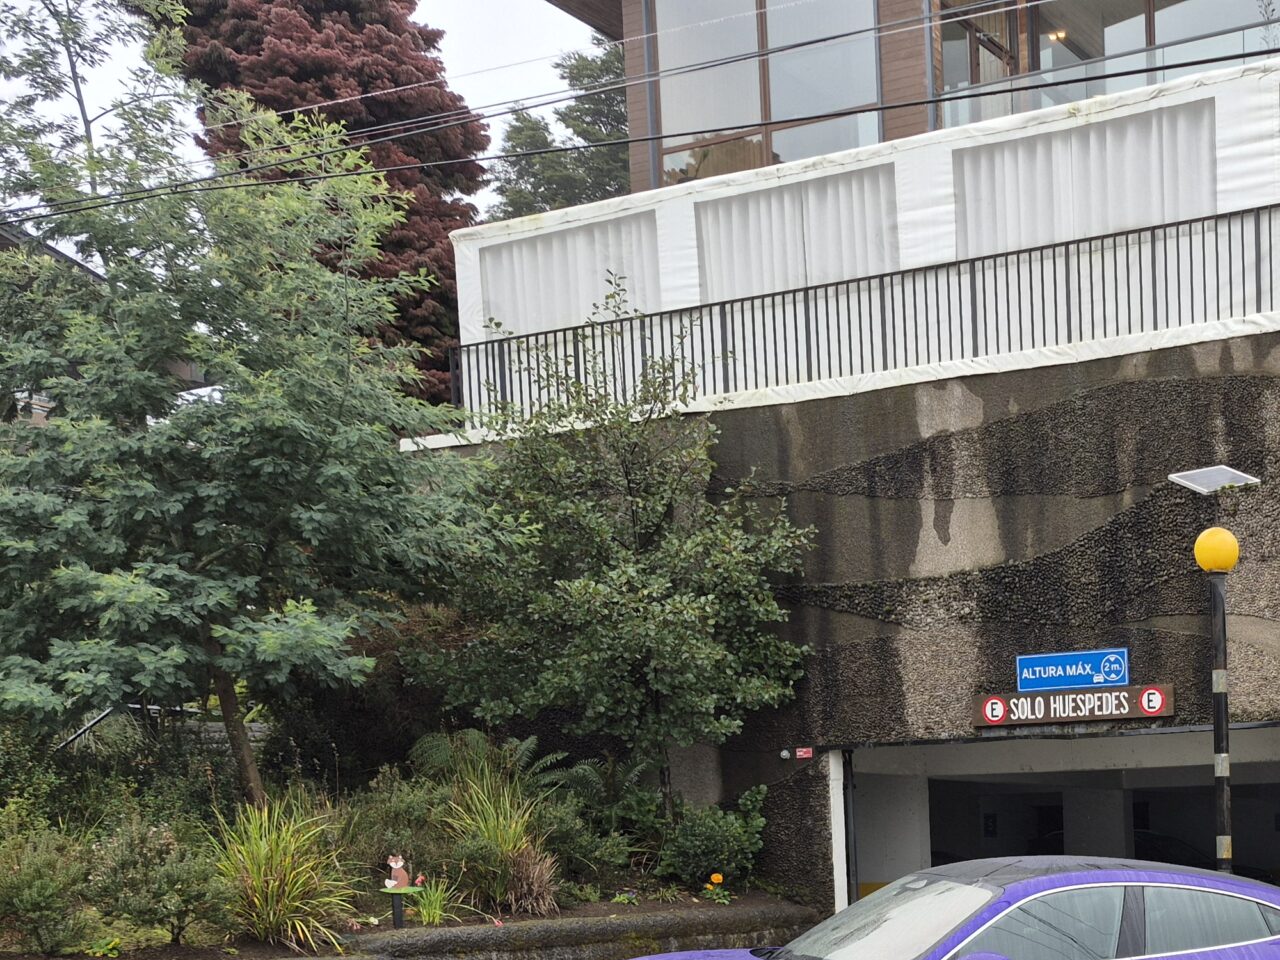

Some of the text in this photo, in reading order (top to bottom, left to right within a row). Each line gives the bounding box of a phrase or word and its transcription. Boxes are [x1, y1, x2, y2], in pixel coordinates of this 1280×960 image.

[1021, 661, 1095, 679] ALTURA MÁX.
[1104, 663, 1110, 671] 2
[990, 692, 1156, 721] E SOLO HUESPEDES E
